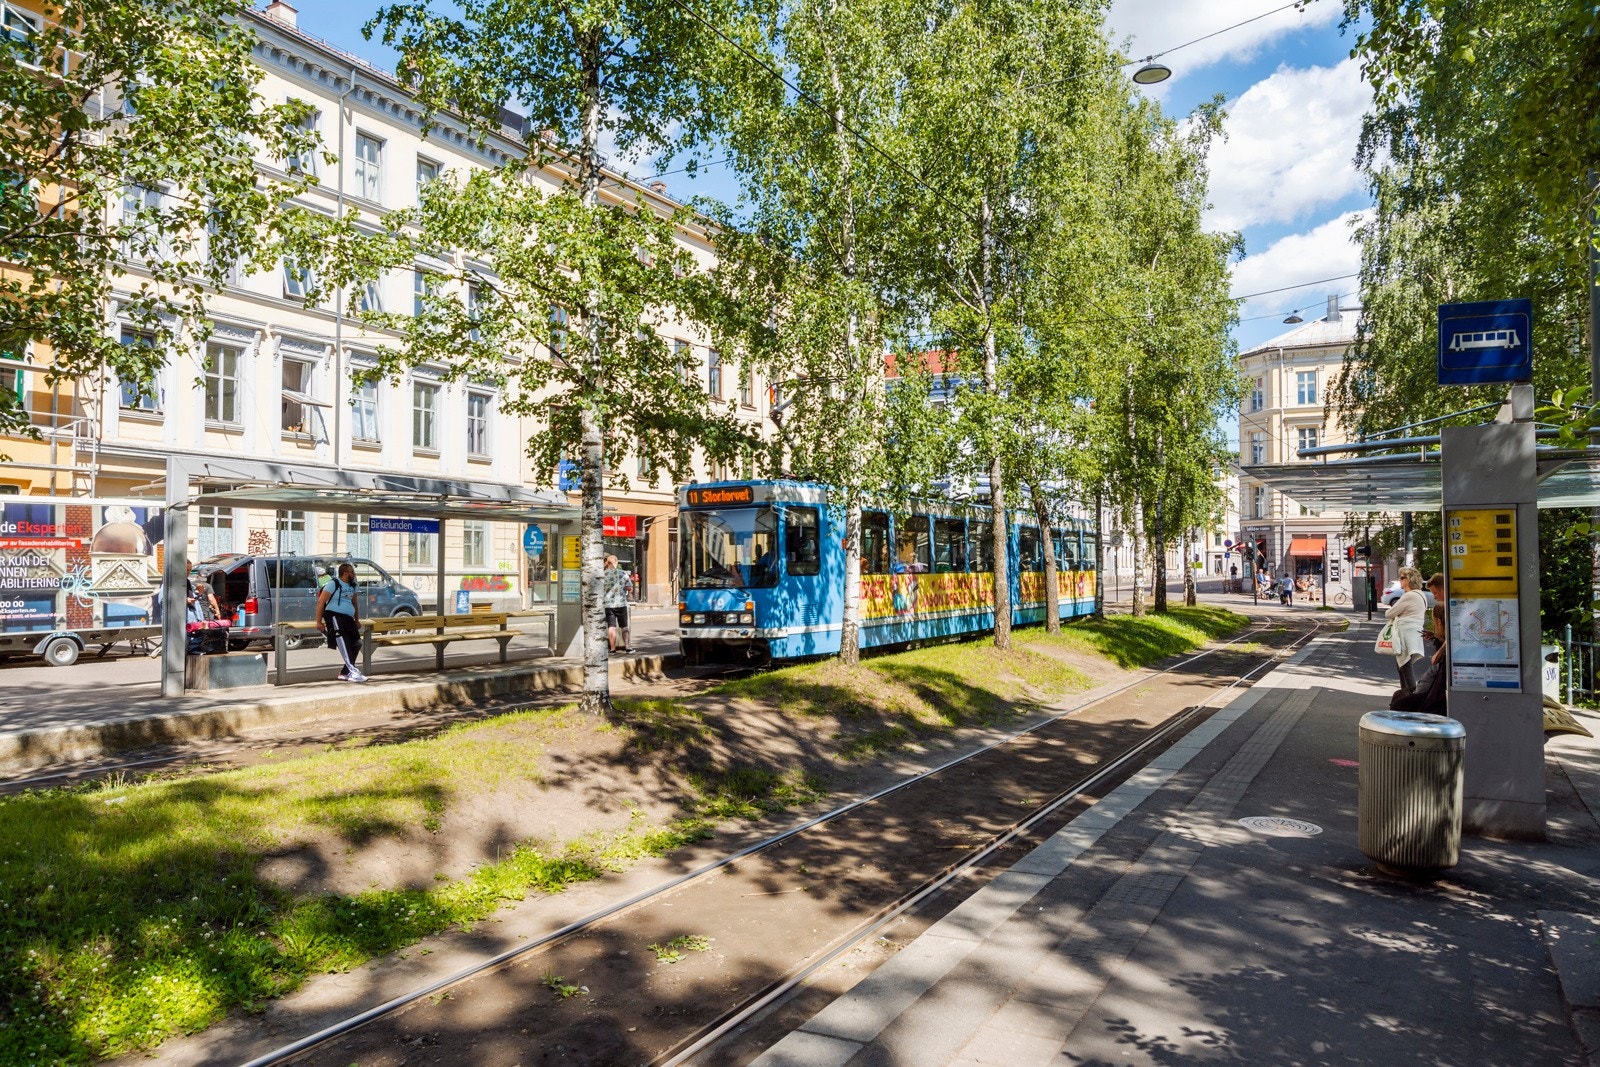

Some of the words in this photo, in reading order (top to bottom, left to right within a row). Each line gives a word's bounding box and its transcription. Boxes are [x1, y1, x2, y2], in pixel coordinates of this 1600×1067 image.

[689, 491, 698, 503] 11
[702, 489, 749, 502] Stortorvet
[370, 520, 413, 530] Birkelunden
[529, 531, 538, 545] 5
[1454, 546, 1465, 554] 18
[8, 556, 30, 566] KUN
[32, 556, 51, 566] DET
[0, 578, 60, 588] ABILITERING
